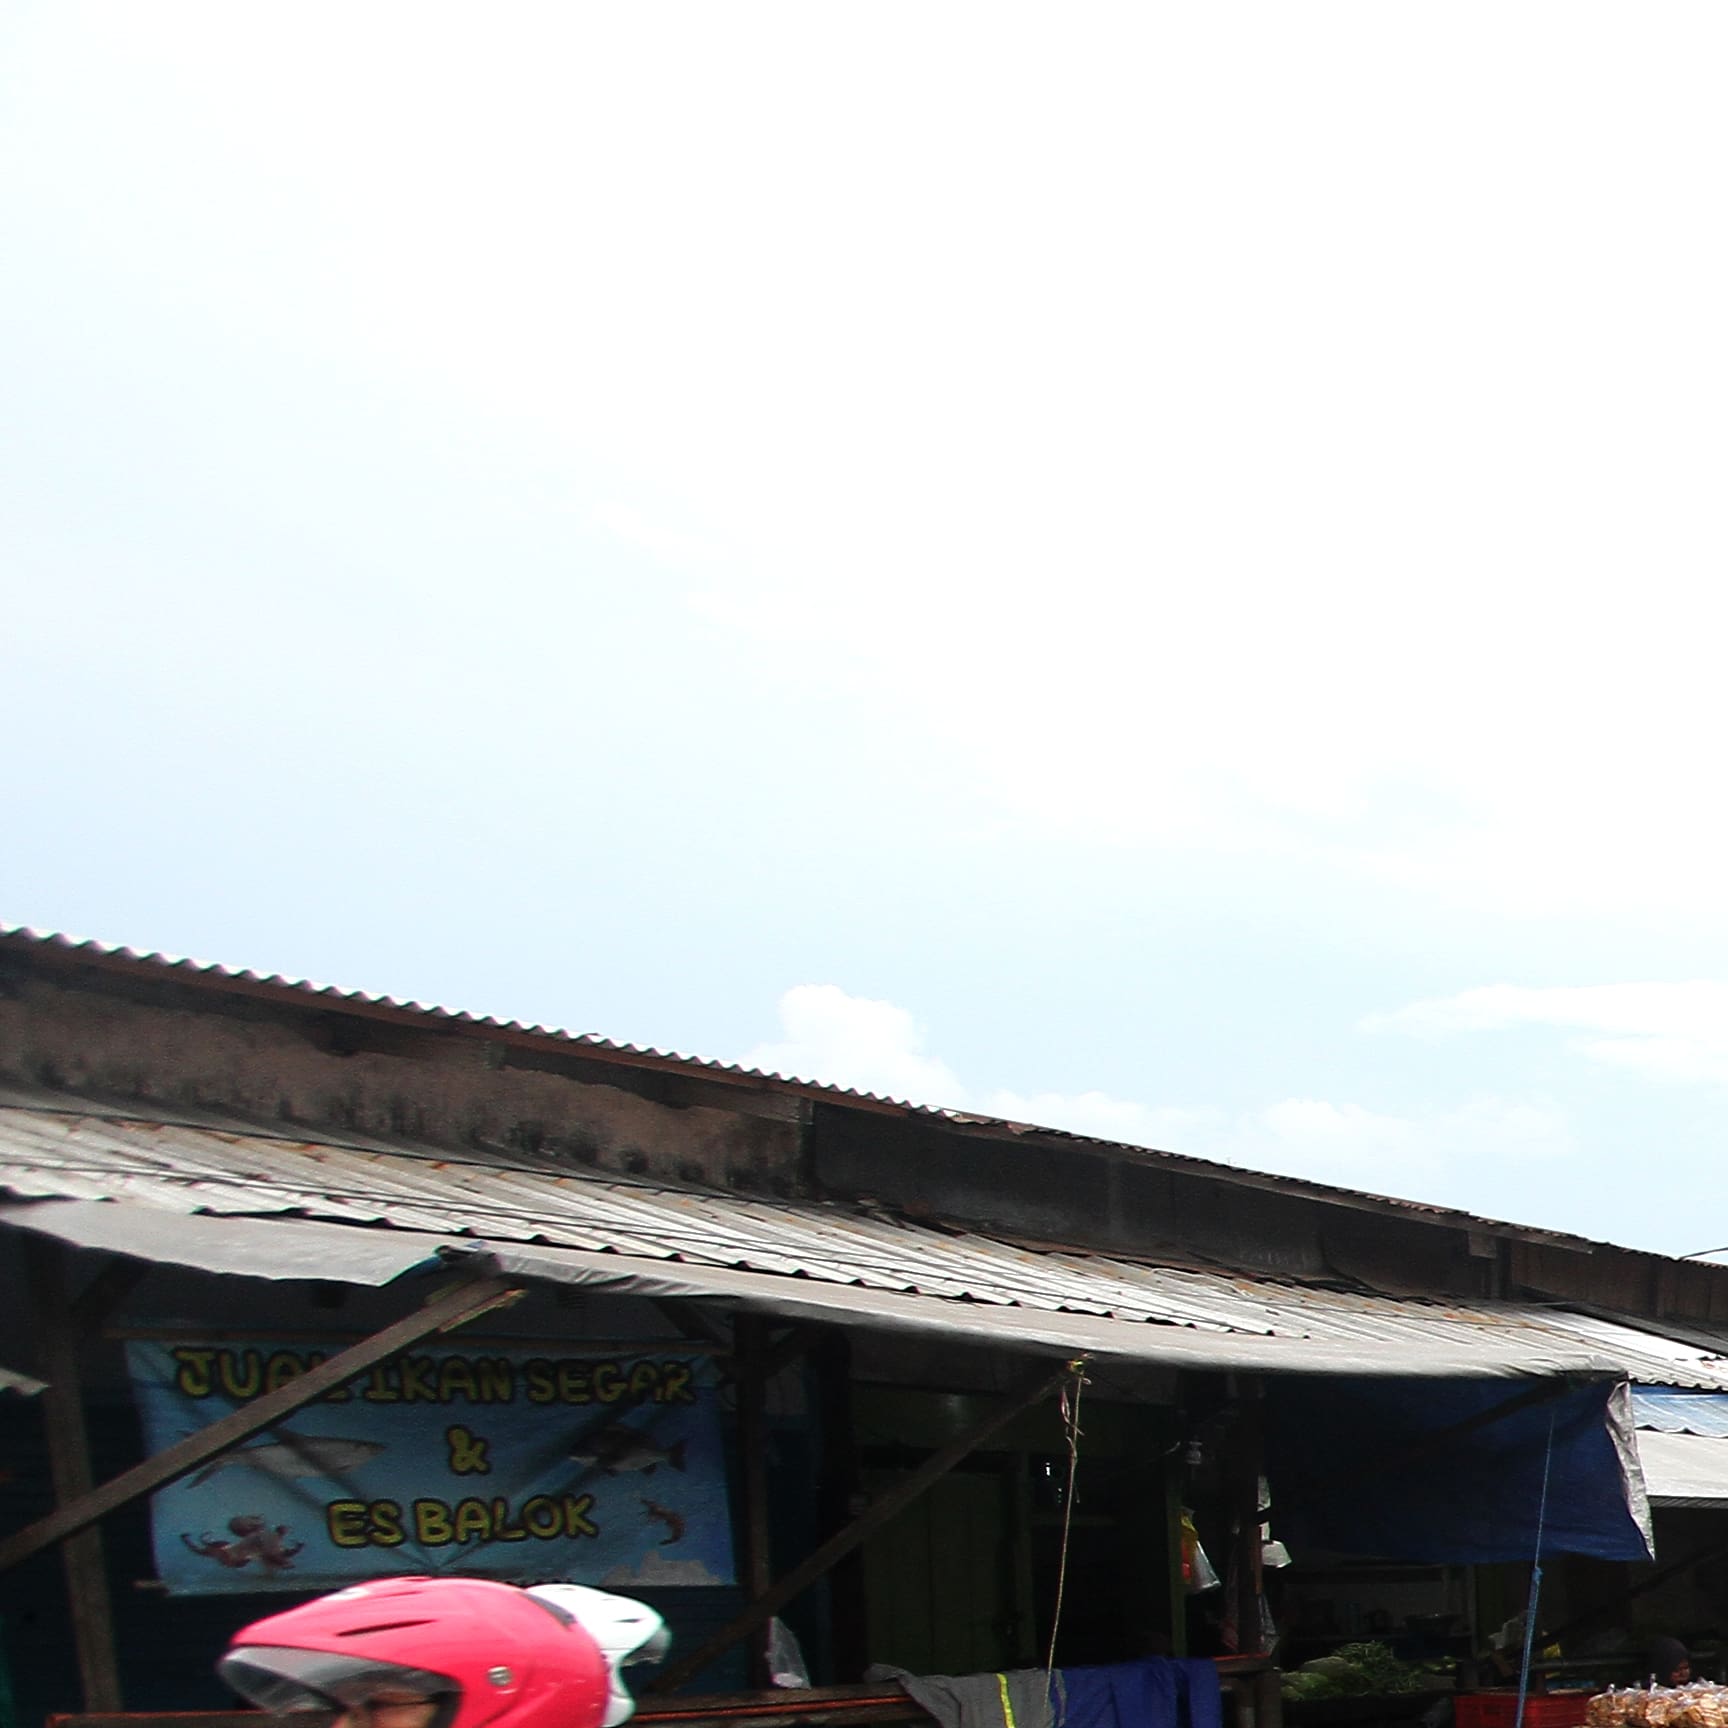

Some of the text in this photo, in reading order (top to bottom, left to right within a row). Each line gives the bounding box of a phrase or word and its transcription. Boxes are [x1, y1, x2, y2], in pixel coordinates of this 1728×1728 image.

[364, 1356, 512, 1402] IKAN
[527, 1358, 697, 1404] SEGAR
[448, 1426, 490, 1474] &
[328, 1494, 597, 1547] ES BALOK
